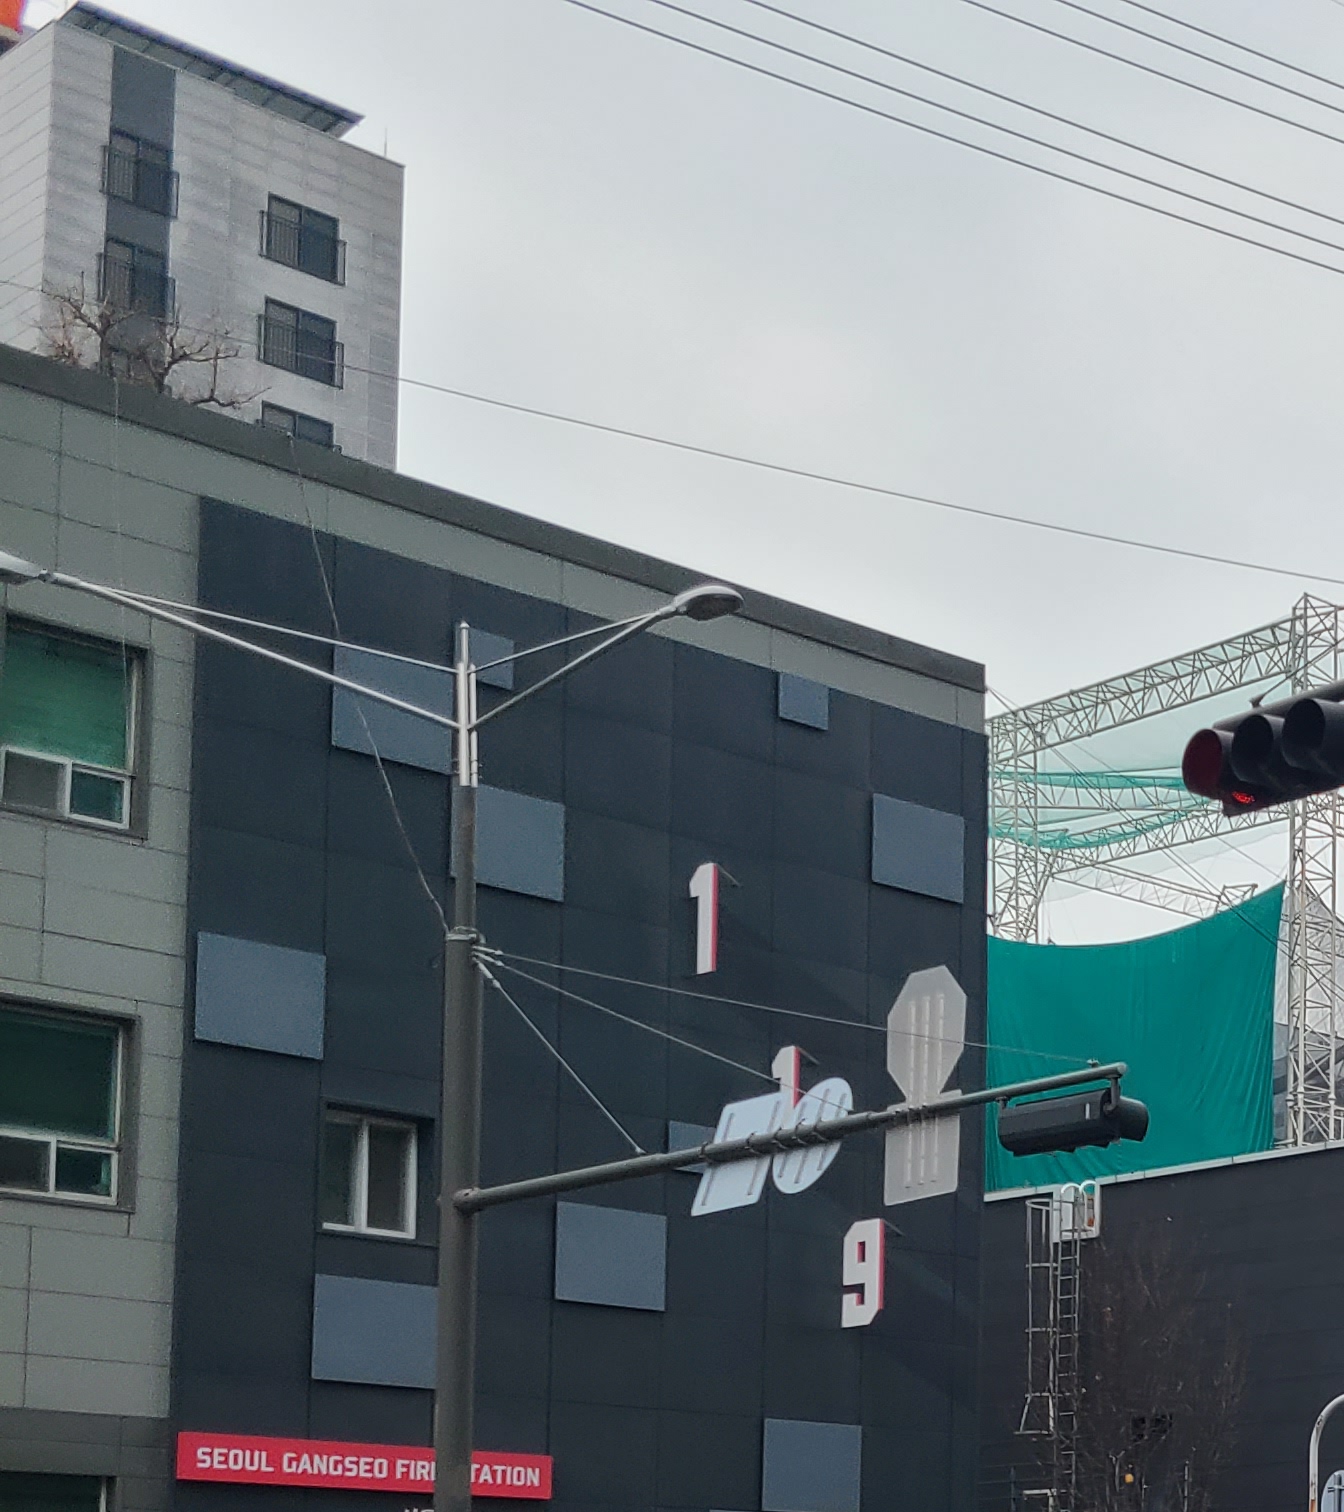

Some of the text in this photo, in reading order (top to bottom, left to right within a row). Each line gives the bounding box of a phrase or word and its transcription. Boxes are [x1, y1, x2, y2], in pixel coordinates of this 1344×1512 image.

[196, 1447, 541, 1487] SEOUL GANGSEO FIR TATION
